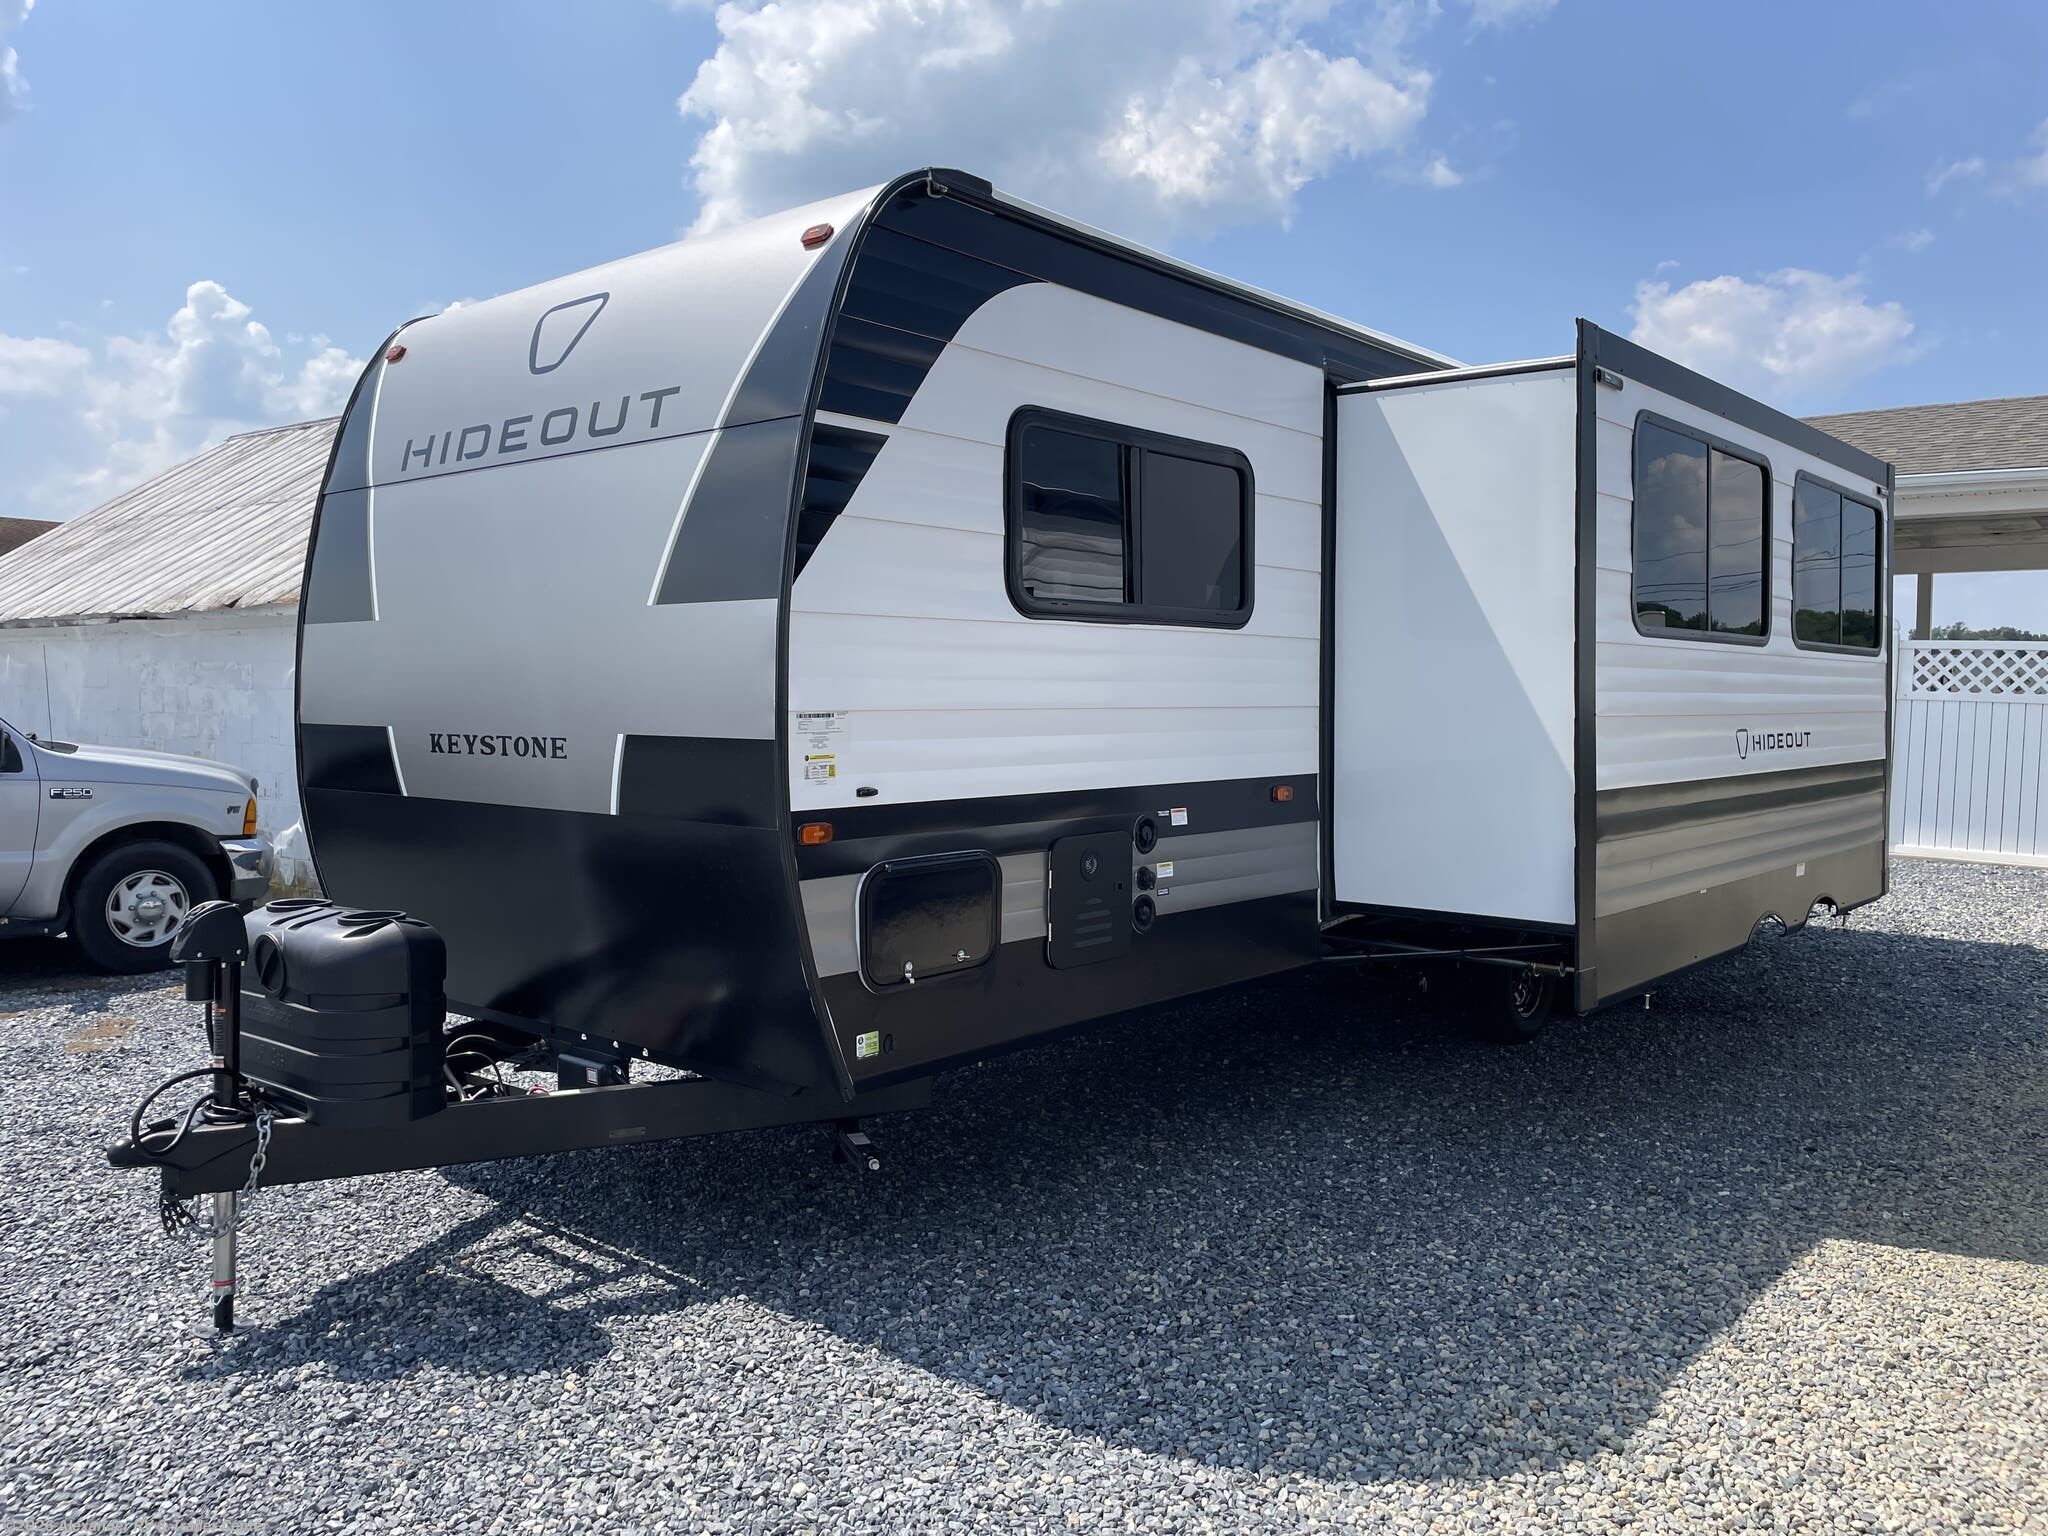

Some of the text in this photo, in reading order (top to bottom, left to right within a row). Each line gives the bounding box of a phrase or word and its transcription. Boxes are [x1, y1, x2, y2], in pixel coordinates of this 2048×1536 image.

[401, 385, 681, 472] HIDEOUT
[428, 732, 568, 760] KEYSTONE
[1751, 731, 1812, 752] HIDEOUT
[50, 788, 93, 796] F250
